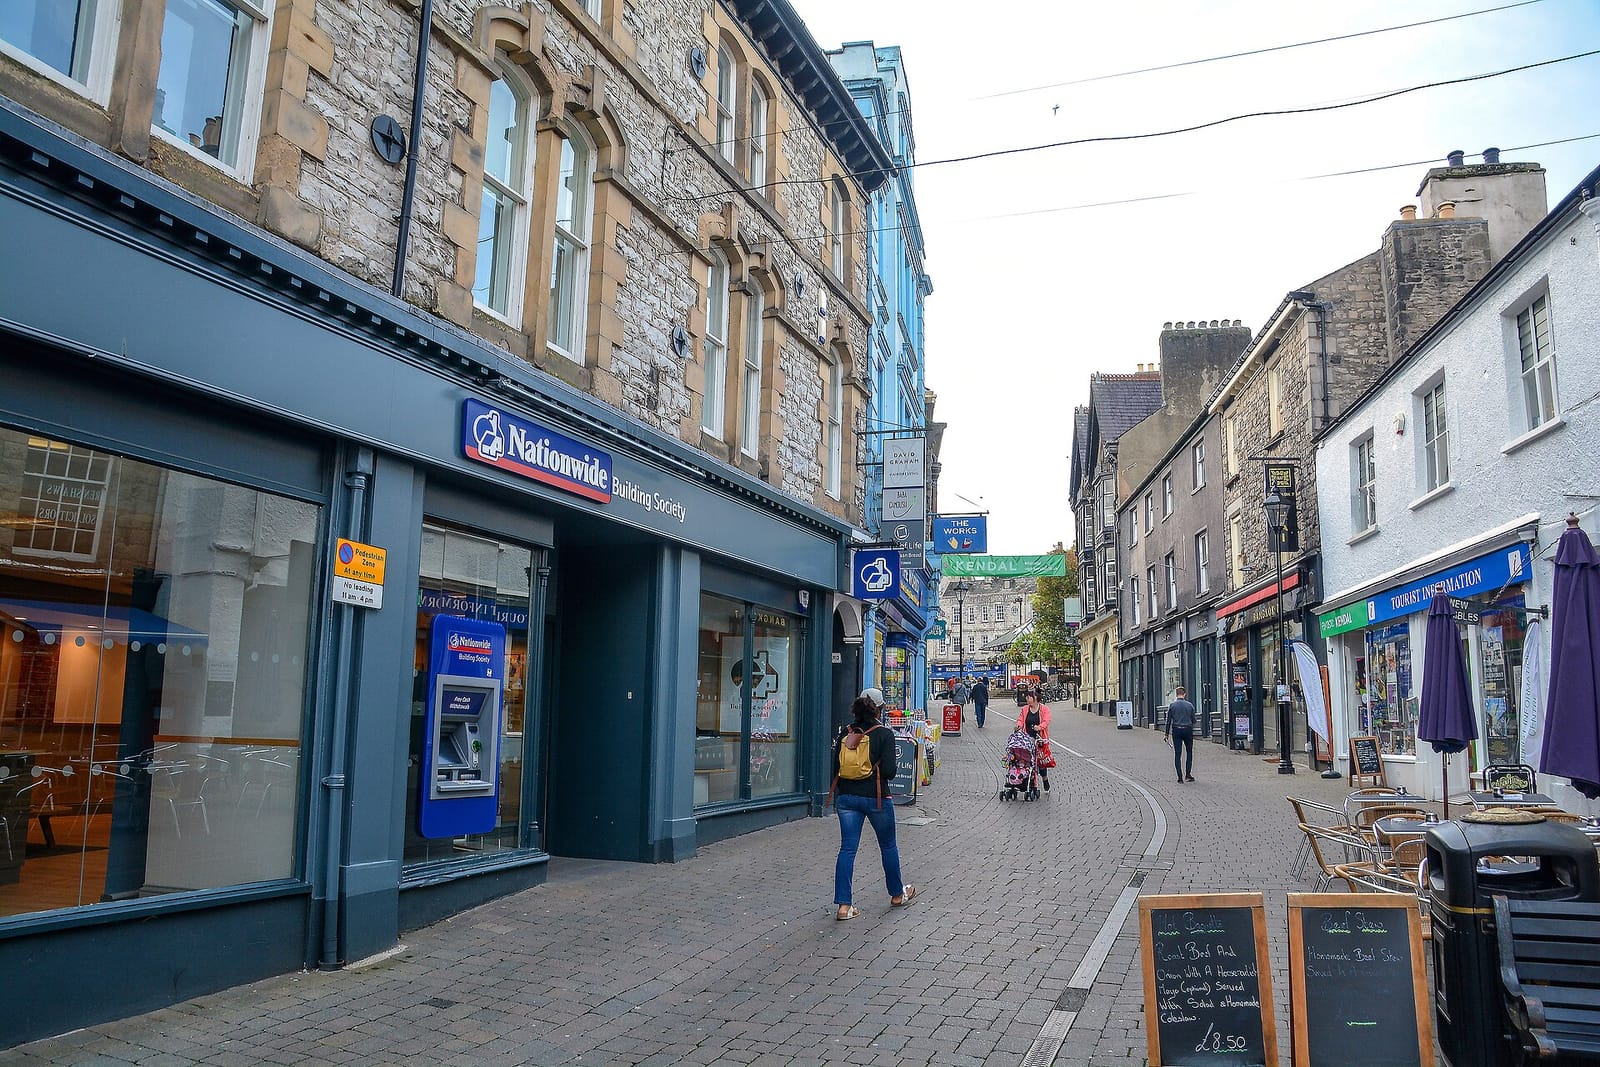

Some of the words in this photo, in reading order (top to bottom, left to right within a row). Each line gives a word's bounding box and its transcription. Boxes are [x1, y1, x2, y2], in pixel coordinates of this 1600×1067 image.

[507, 423, 608, 490] Nationwide
[612, 476, 652, 512] Building
[653, 493, 687, 523] Society
[943, 527, 977, 535] WORKS
[909, 541, 923, 549] Life
[355, 548, 384, 561] Pedestrian
[362, 559, 376, 568] Zone
[955, 561, 1017, 571] KENDAL
[352, 569, 362, 577] any
[363, 571, 376, 579] time
[343, 581, 352, 589] No
[353, 583, 374, 594] loading
[1391, 588, 1421, 610] TOURIST
[1449, 598, 1469, 610] NEW
[1335, 611, 1353, 628] KENDAL
[459, 636, 491, 649] Nationwide
[458, 653, 475, 663] Building
[475, 654, 490, 664] Society
[901, 762, 913, 770] Life
[1320, 911, 1351, 931] Beef
[1355, 911, 1384, 930] Stew
[1156, 942, 1185, 961] Roast
[1185, 941, 1211, 960] Beef
[1217, 945, 1237, 957] And
[1353, 948, 1376, 962] Beef
[1157, 969, 1182, 981] Onion
[1184, 965, 1202, 978] With
[1205, 965, 1213, 976] A
[1159, 984, 1180, 1000] Mayo
[1181, 981, 1211, 995] (optional)
[1216, 981, 1245, 992] Served
[1160, 998, 1183, 1010] With
[1187, 998, 1215, 1008] Salad
[1195, 1022, 1246, 1052] £8.50
